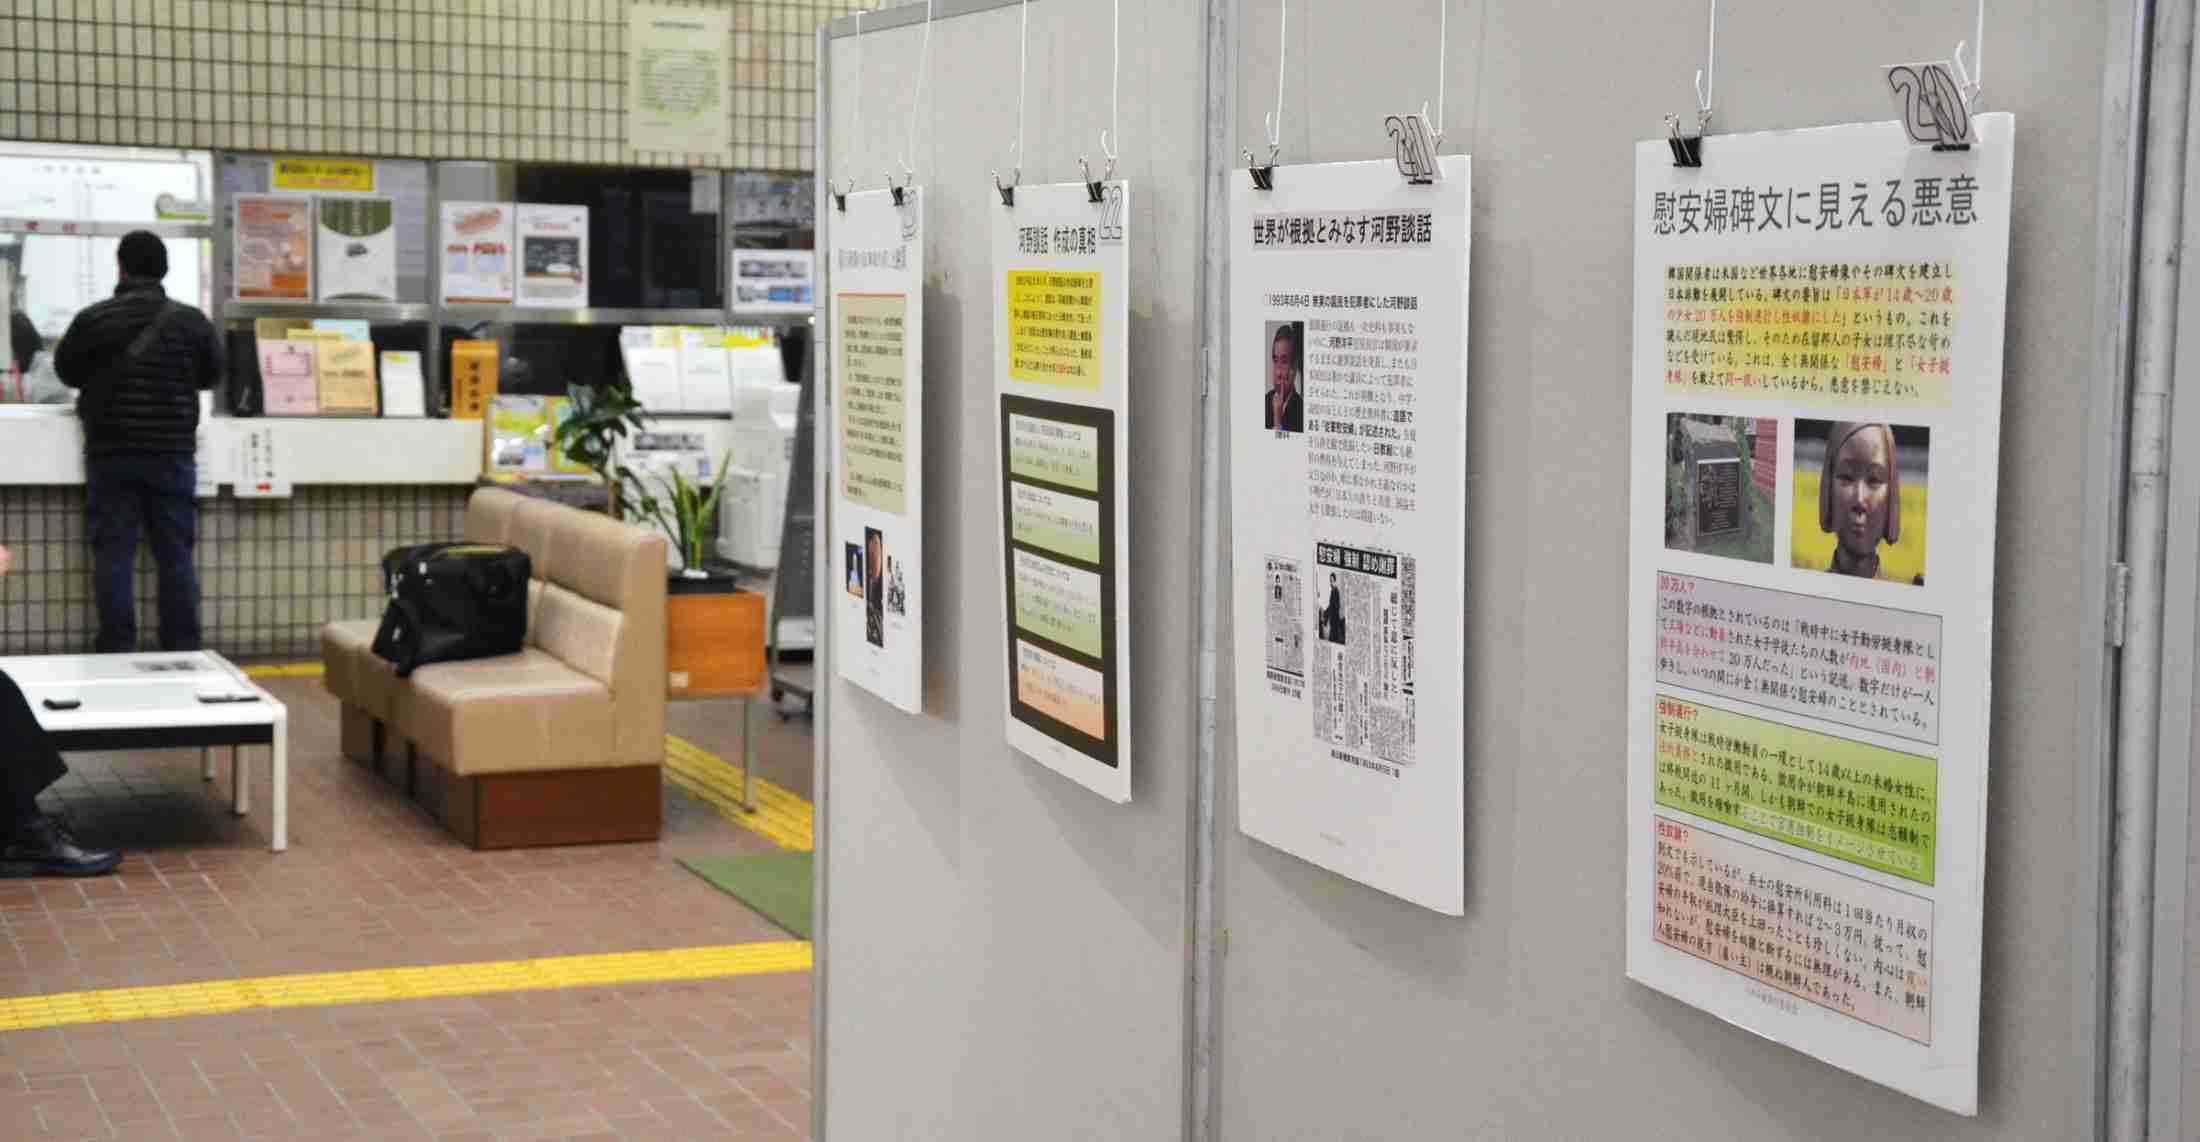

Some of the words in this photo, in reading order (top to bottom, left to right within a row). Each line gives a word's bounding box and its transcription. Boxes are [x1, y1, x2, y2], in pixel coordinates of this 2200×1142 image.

[1653, 173, 1980, 236] 慰安婦碑文に見える悪意
[1252, 213, 1432, 247] 世界が根拠とみなす河野談話
